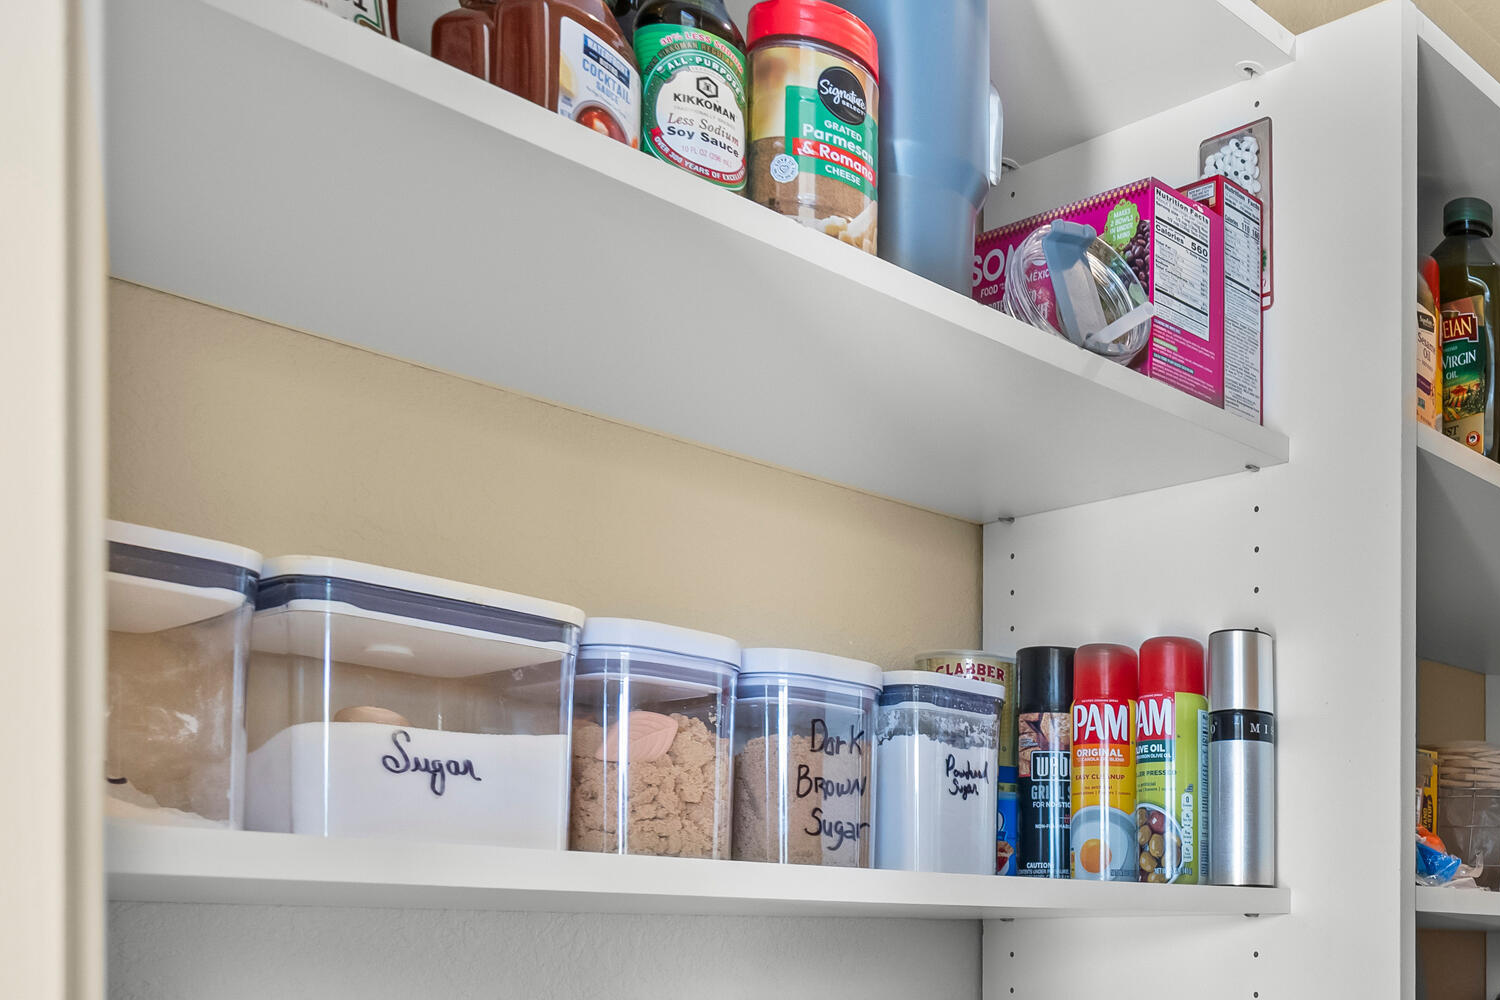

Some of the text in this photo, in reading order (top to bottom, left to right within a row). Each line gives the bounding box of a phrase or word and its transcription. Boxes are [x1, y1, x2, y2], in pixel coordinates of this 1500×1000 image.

[582, 58, 631, 105] COCKTAIL
[820, 79, 866, 110] Signature
[673, 92, 736, 123] KIKKOMAN
[667, 112, 694, 127] Less
[699, 118, 740, 147] Sodium
[667, 125, 740, 158] Soy Sauce
[802, 123, 874, 166] Parmesan
[824, 119, 862, 142] GRATED
[711, 168, 721, 180] OF
[819, 143, 873, 182] Romano
[825, 165, 861, 185] CHEESE
[1156, 188, 1209, 225] Nutrition Facts
[1155, 224, 1208, 257] Calories 560
[980, 284, 998, 298] FOOD
[1446, 370, 1458, 379] OIL
[936, 662, 1005, 683] CLABBER
[811, 719, 864, 756] Dark
[1073, 703, 1129, 742] PAM
[381, 729, 481, 796] Sugar
[1076, 748, 1123, 757] ORIGINAL
[1150, 743, 1165, 753] OIL
[1033, 801, 1045, 809] FOR
[804, 808, 870, 850] Sugar
